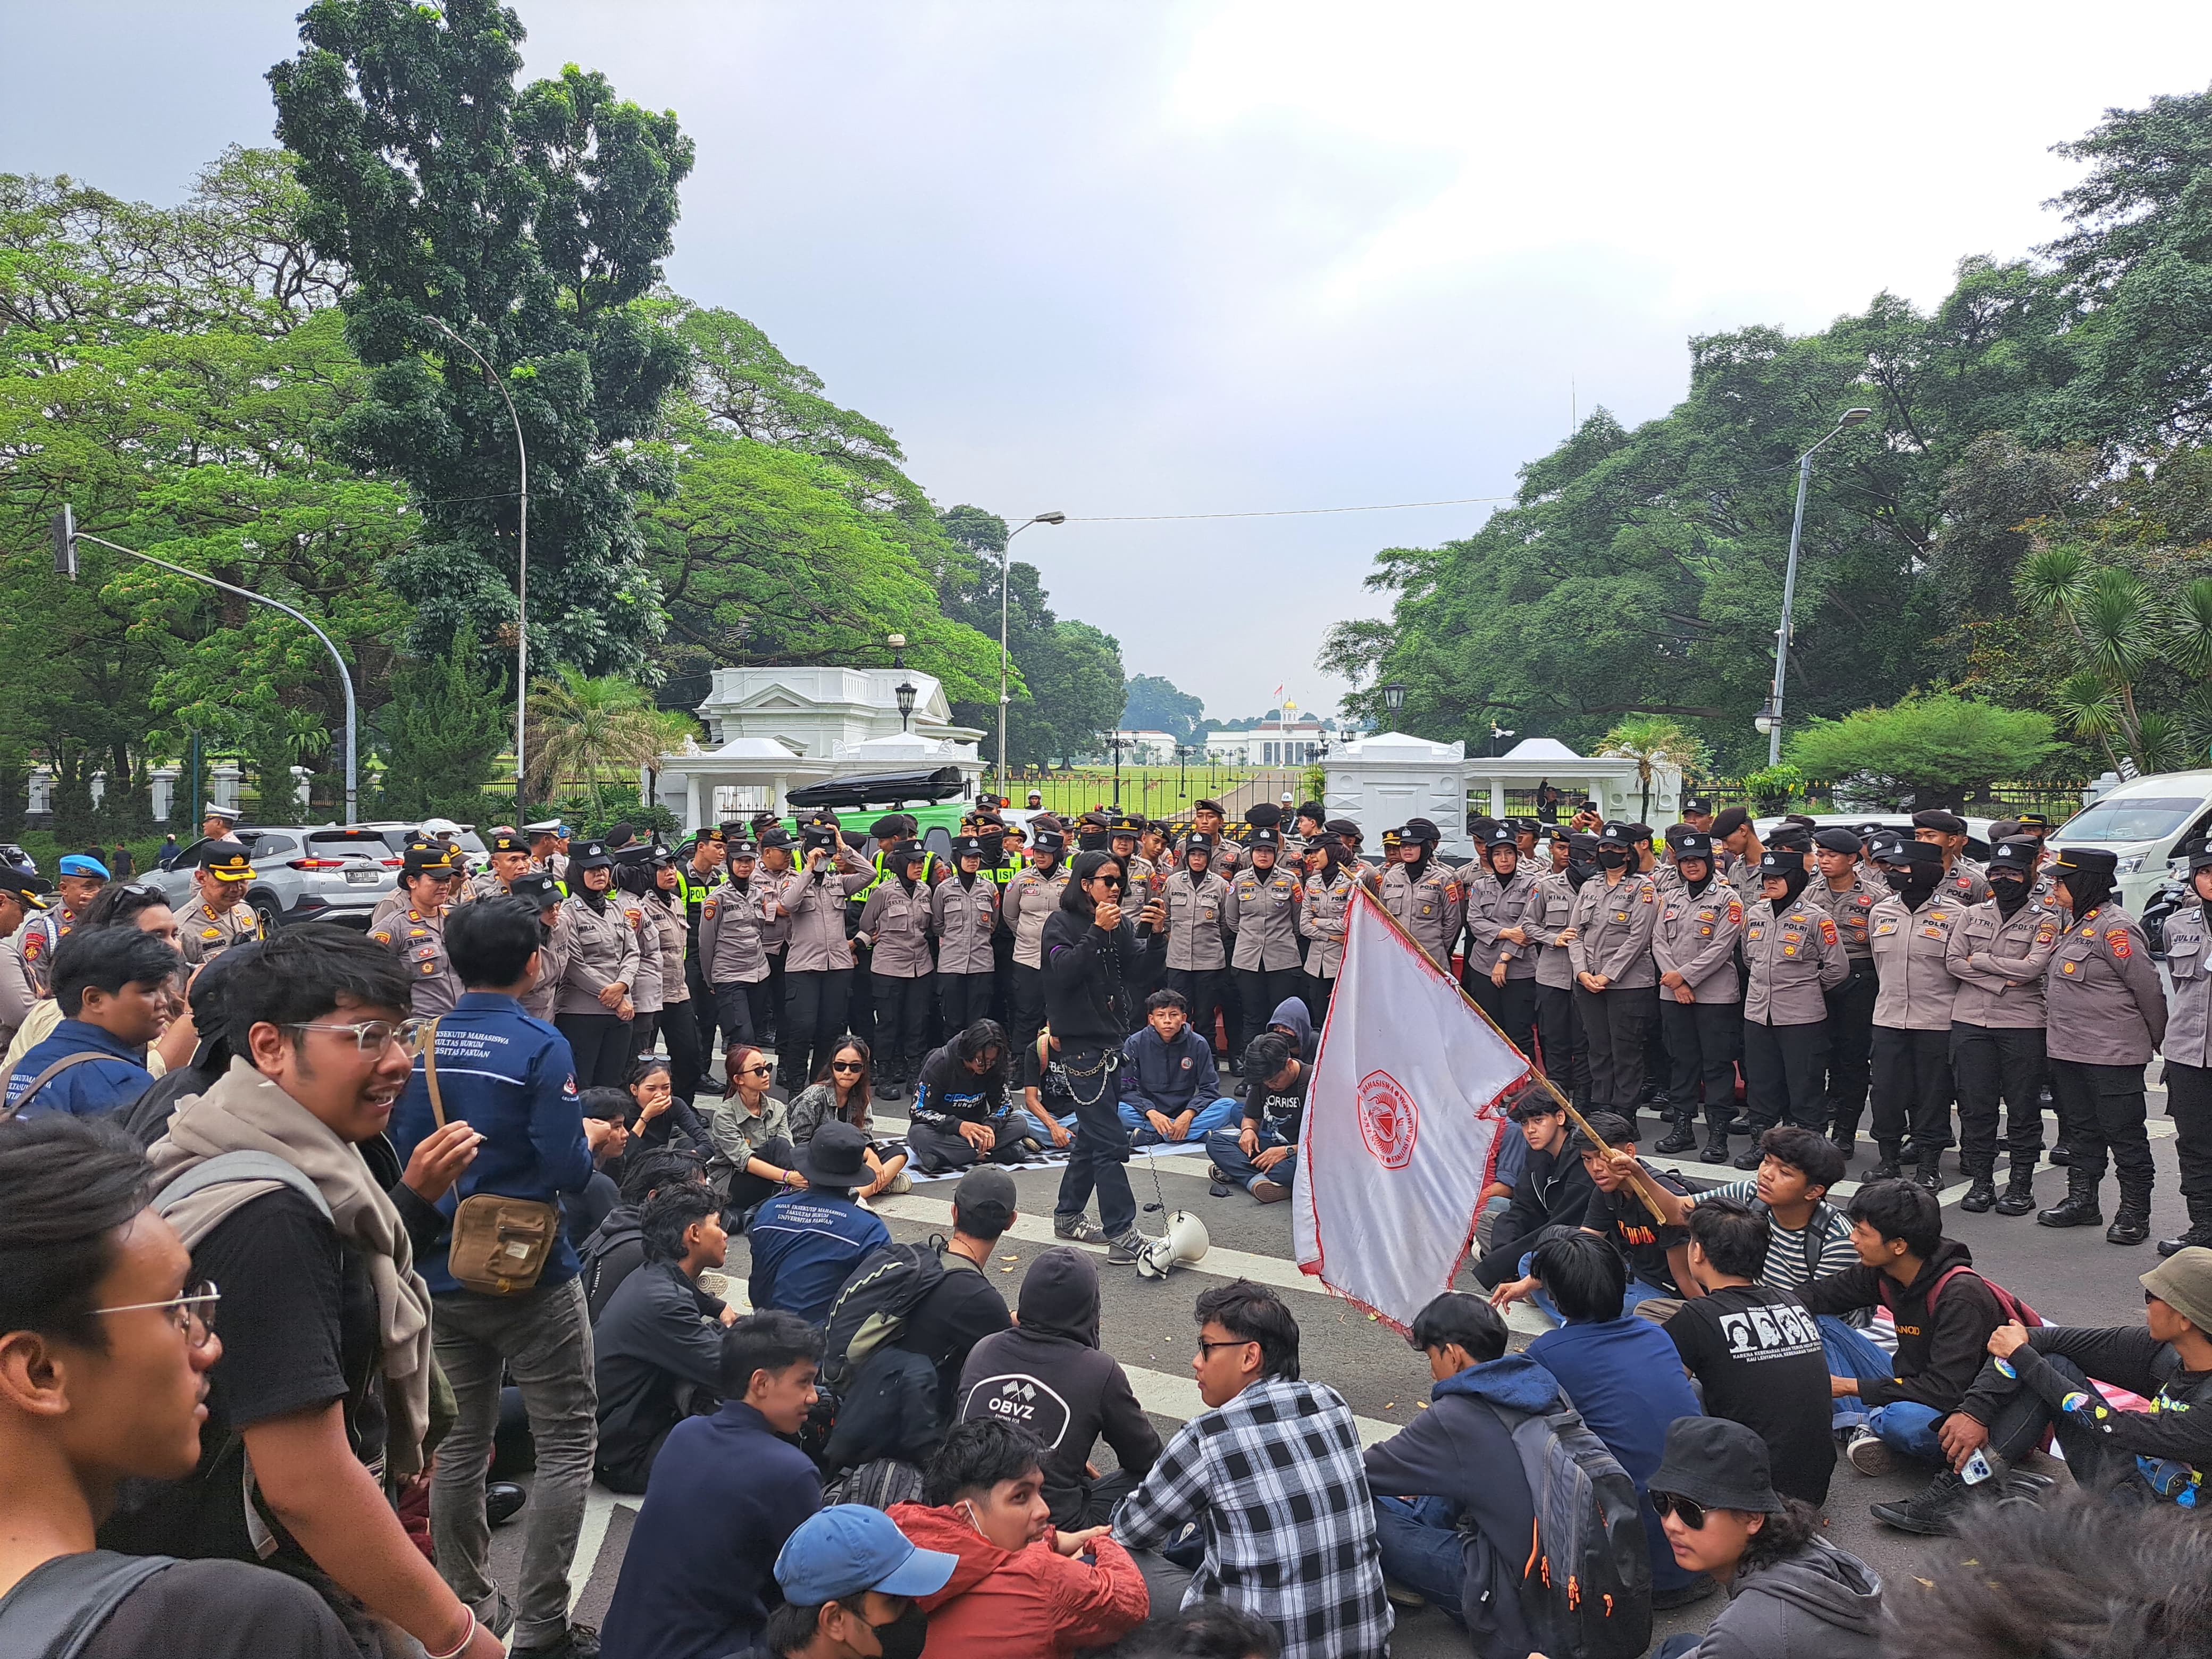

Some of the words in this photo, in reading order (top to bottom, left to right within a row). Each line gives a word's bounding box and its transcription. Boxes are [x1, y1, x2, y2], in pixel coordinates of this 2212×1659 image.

[999, 871, 1012, 879] ISI
[1947, 889, 1973, 900] POLRI
[1783, 923, 1807, 932] POLRI
[1923, 919, 1949, 929] POLRI
[1969, 917, 1993, 928] FITRI
[468, 1032, 509, 1045] MAHASISWA
[460, 1040, 484, 1048] HUKUM
[462, 1048, 490, 1058] PAKUAN
[1362, 1080, 1394, 1096] MAHASISWA
[817, 1208, 847, 1218] MAHASISWA
[777, 1214, 811, 1224] UNIVERSITAS
[1754, 1348, 1780, 1356] KEBENARAN
[989, 1398, 1035, 1420] OBVZ
